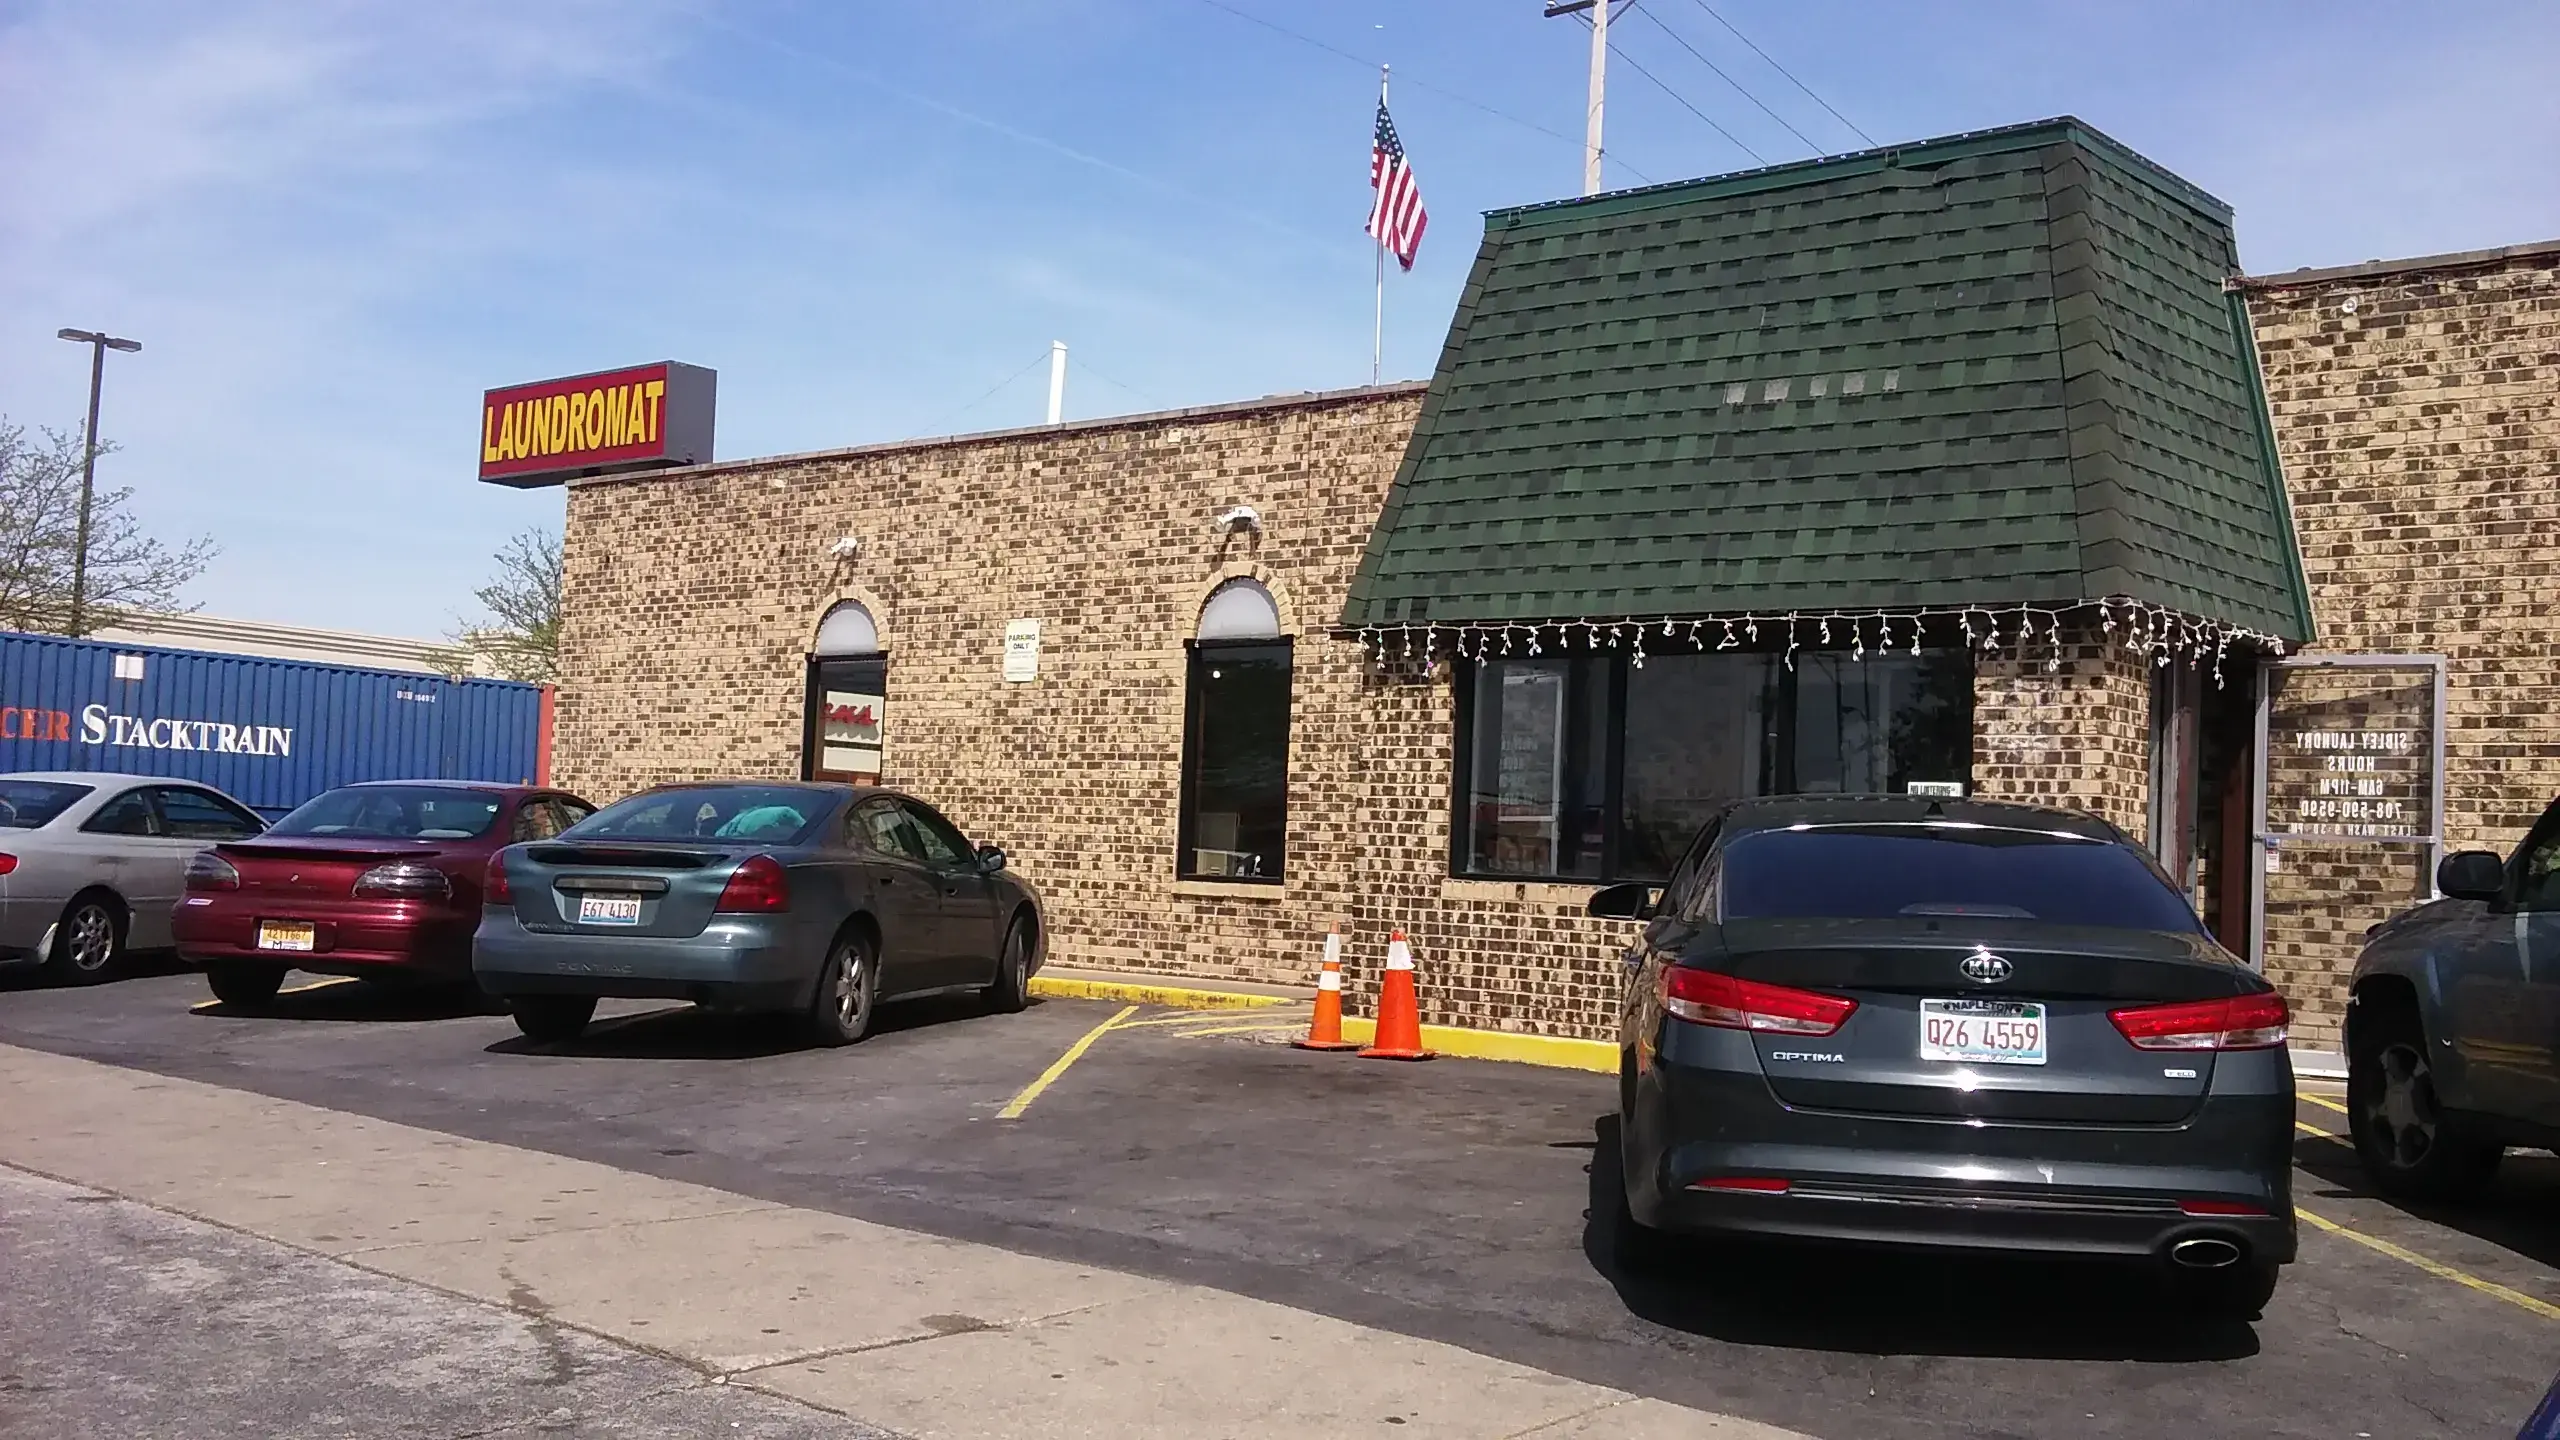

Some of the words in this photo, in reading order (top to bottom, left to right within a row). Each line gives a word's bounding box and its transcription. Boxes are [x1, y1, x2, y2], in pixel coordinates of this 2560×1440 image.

[483, 379, 665, 463] LAUNDROMAT
[1008, 633, 1036, 641] PARKING
[80, 703, 293, 757] STACKTRAIN
[583, 901, 605, 918] E67
[609, 902, 637, 919] 4130
[1969, 960, 2005, 976] KIA
[1951, 1000, 2014, 1011] NAPLETON
[1927, 1018, 1969, 1048] Q26
[1982, 1021, 2039, 1052] 4559
[1772, 1051, 1845, 1062] OPTIMA
